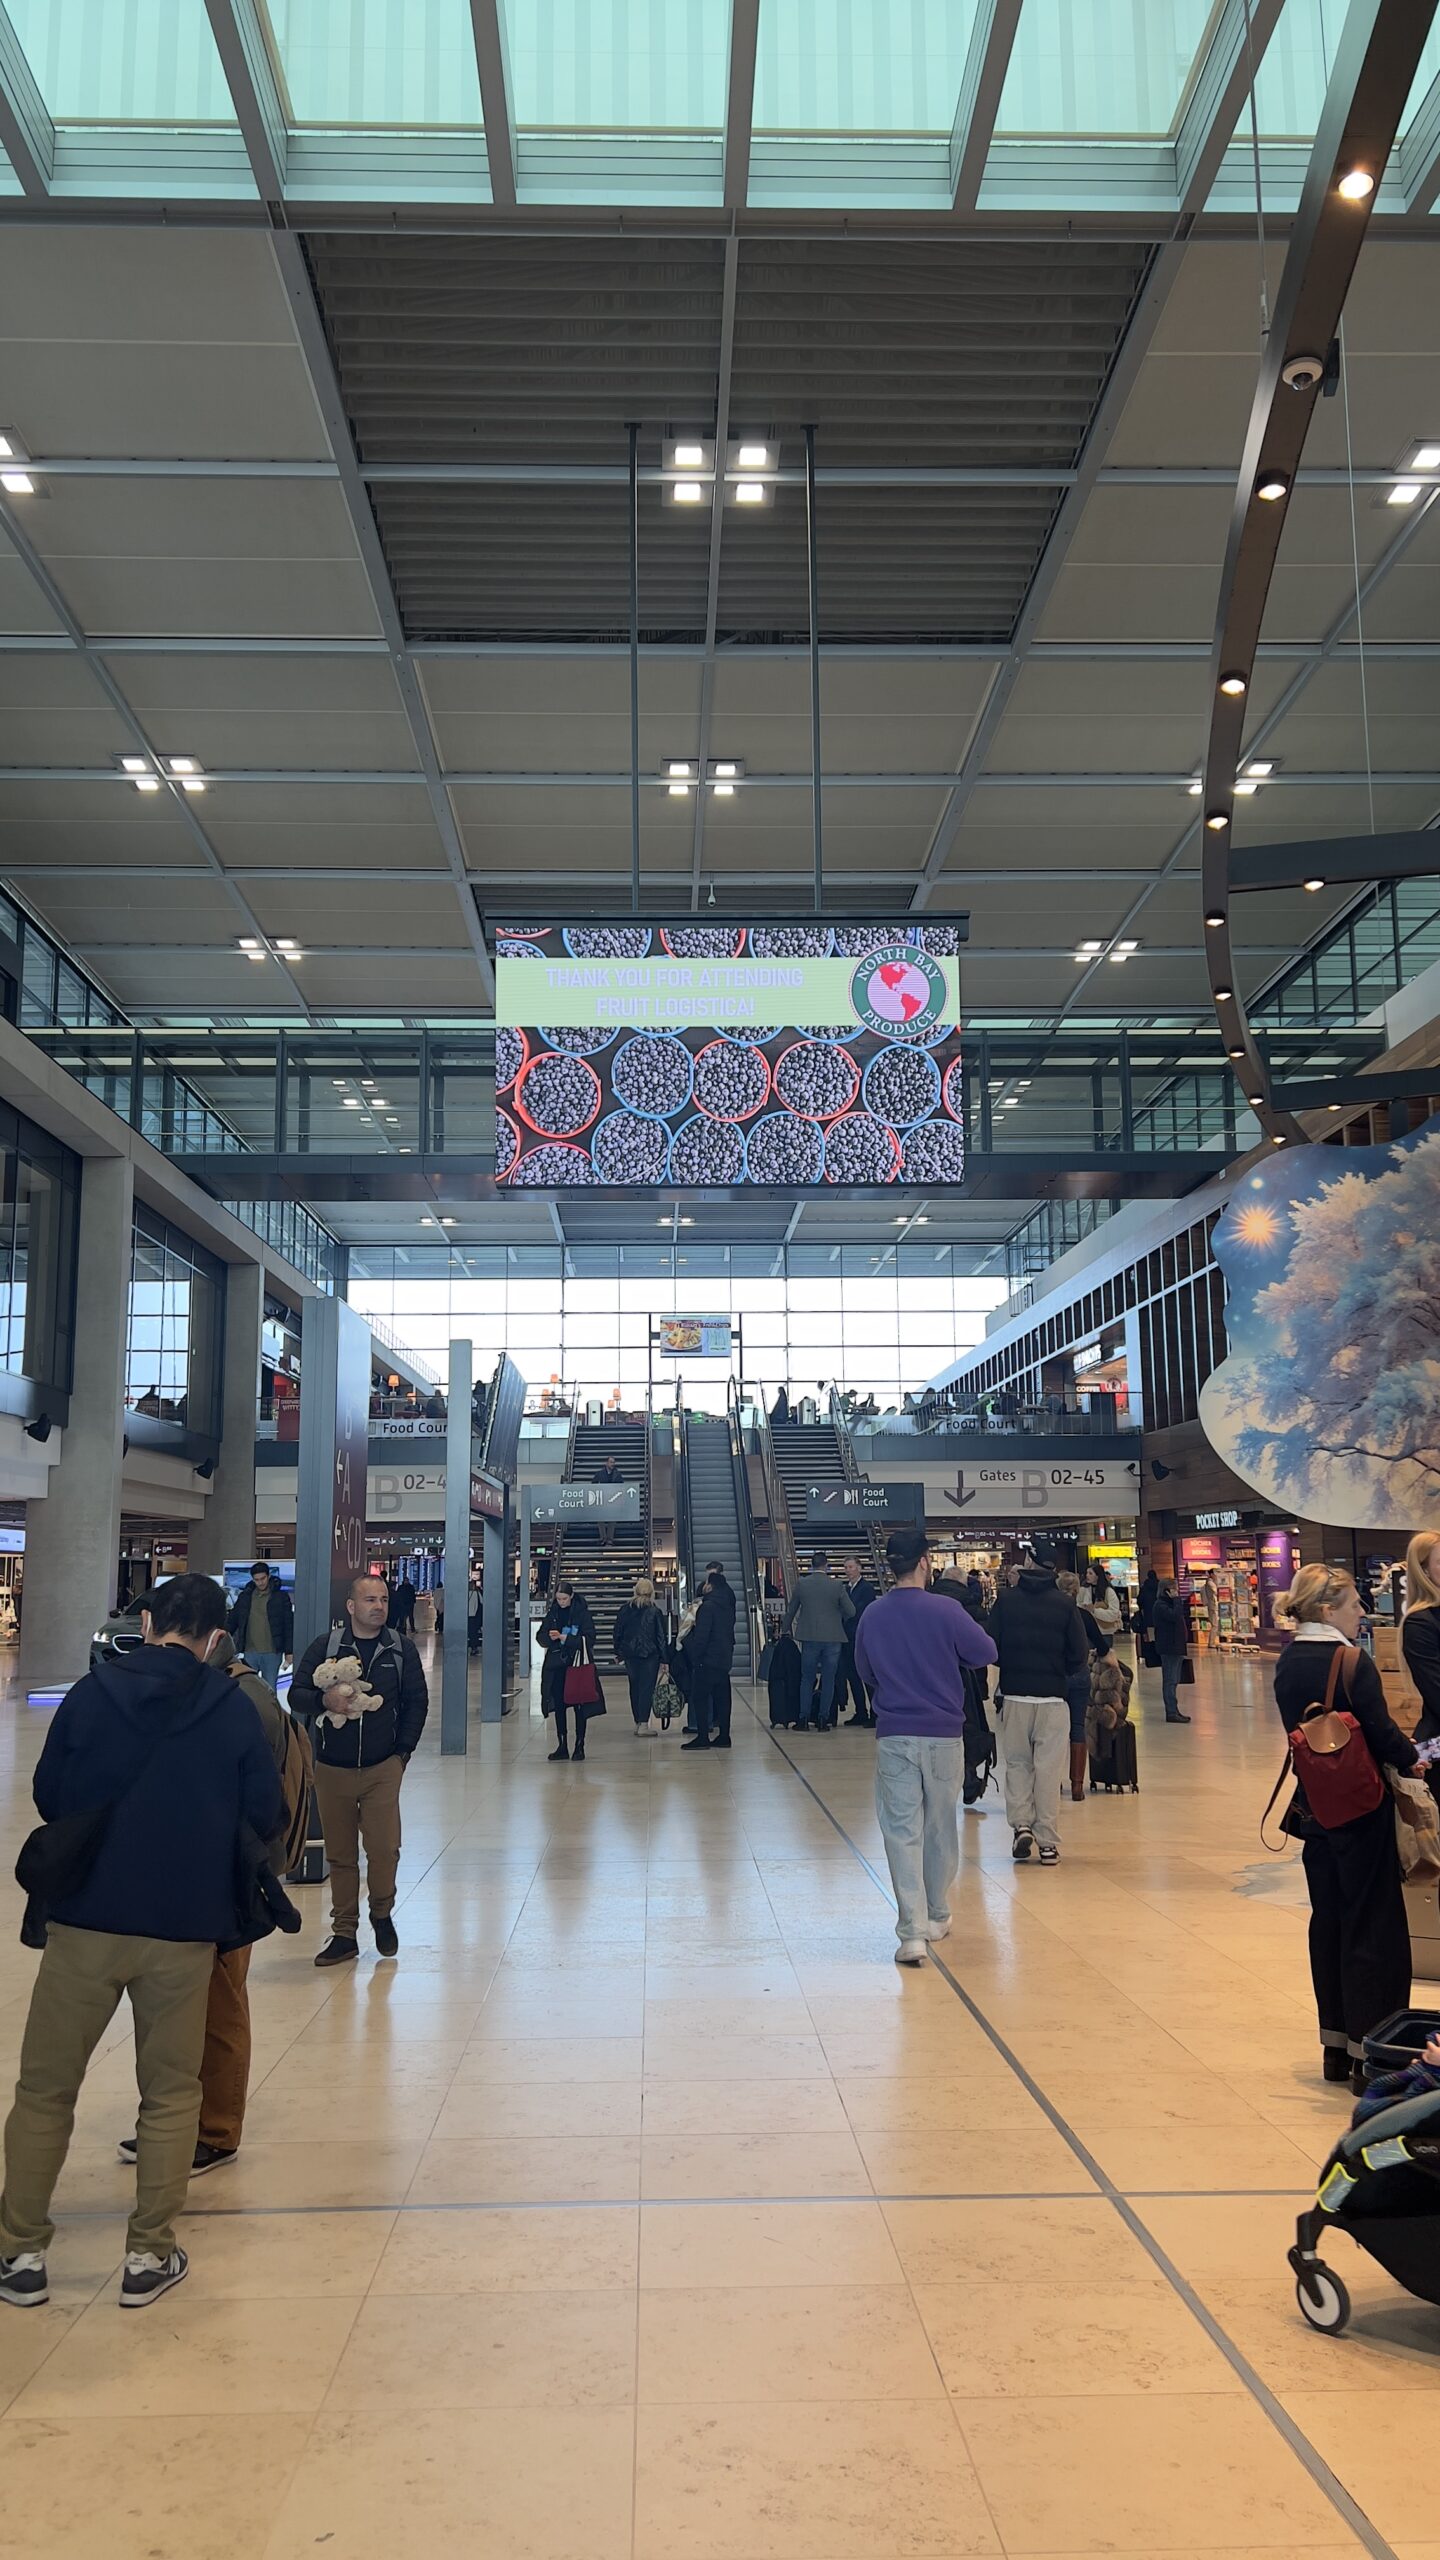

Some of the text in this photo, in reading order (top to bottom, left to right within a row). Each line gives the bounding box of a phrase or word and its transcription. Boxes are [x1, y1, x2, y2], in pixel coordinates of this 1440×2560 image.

[856, 947, 940, 981] NORTH BAY
[545, 968, 805, 988] THANK YOU FOR ATTENDING
[596, 997, 756, 1017] FRUIT LOGISTICA!
[861, 1009, 937, 1035] PRODUCE
[382, 1422, 448, 1434] Food Cour
[946, 1417, 1016, 1430] Food Court
[374, 1473, 446, 1514] B 02-4
[562, 1489, 584, 1498] Food
[862, 1487, 885, 1497] Food
[979, 1469, 1105, 1508] Gates B 02-45
[558, 1499, 584, 1508] Court
[862, 1498, 889, 1507] Court
[1196, 1510, 1238, 1530] POCKET SHOP
